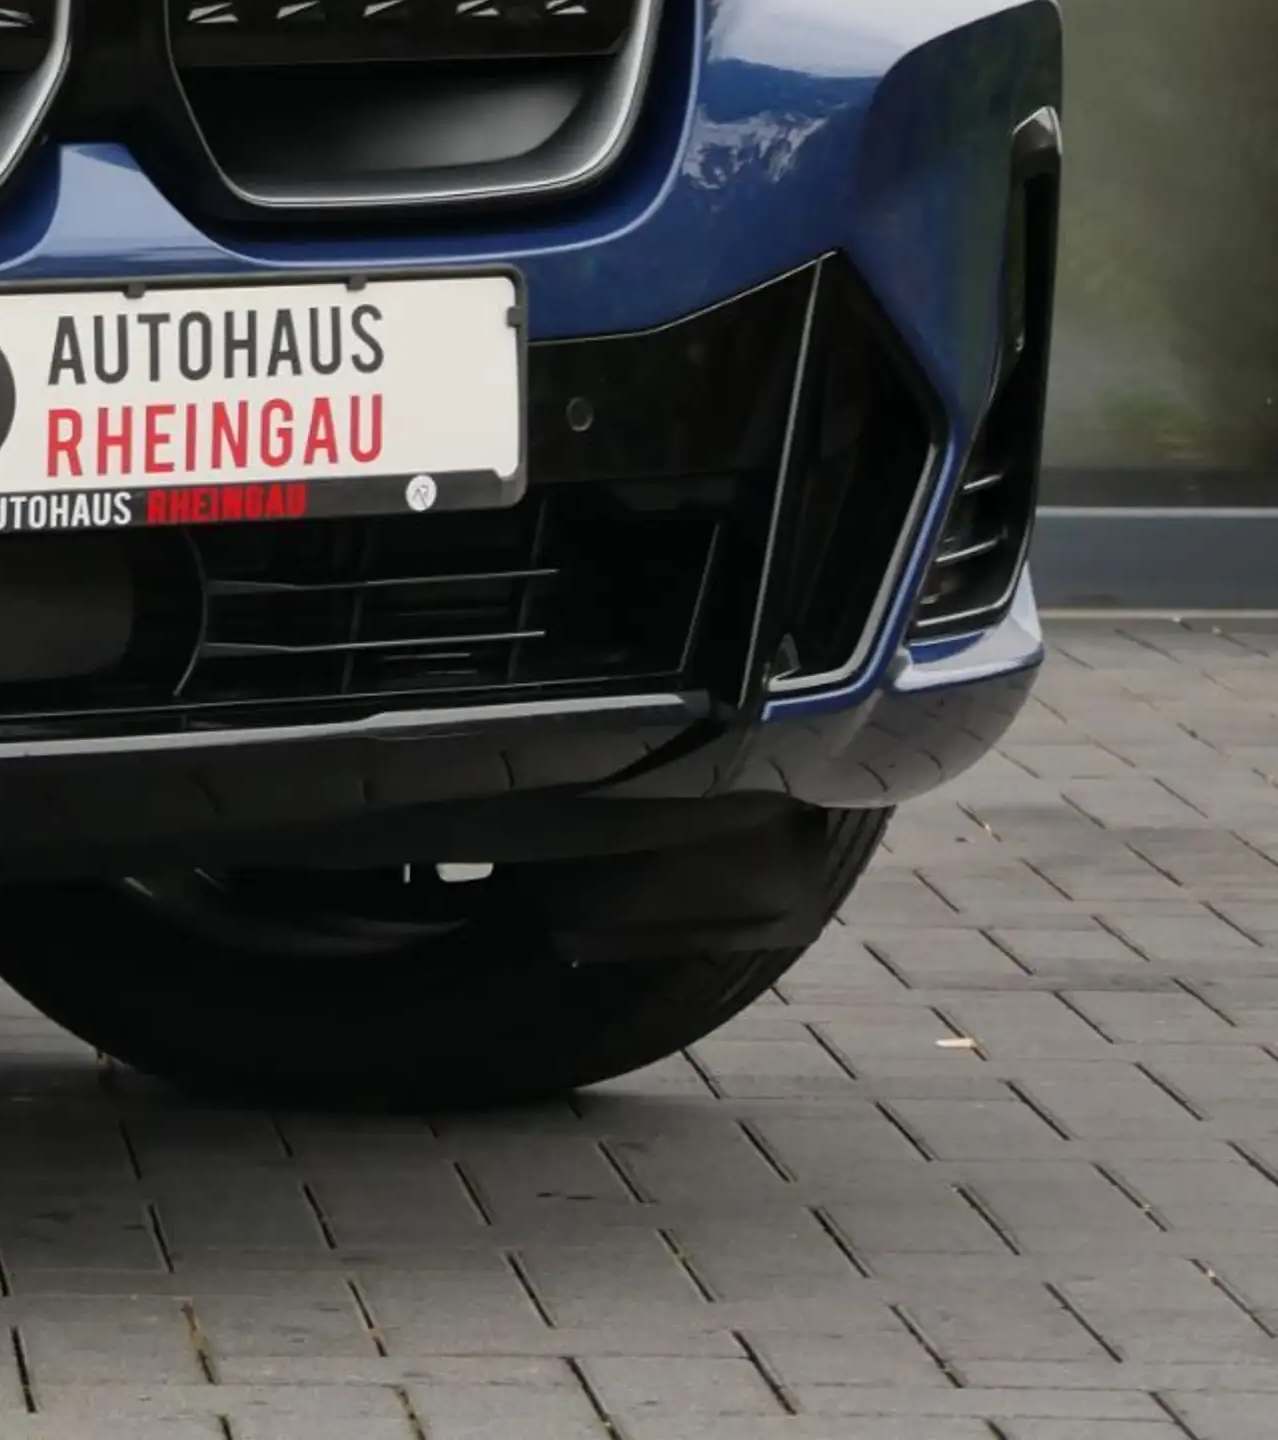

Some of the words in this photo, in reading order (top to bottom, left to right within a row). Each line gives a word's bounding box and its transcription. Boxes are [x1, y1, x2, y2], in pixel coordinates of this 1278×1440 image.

[47, 303, 385, 386] AUTOHAUS
[46, 394, 383, 478] RHEINGAU
[146, 483, 307, 524] RHEINGAU
